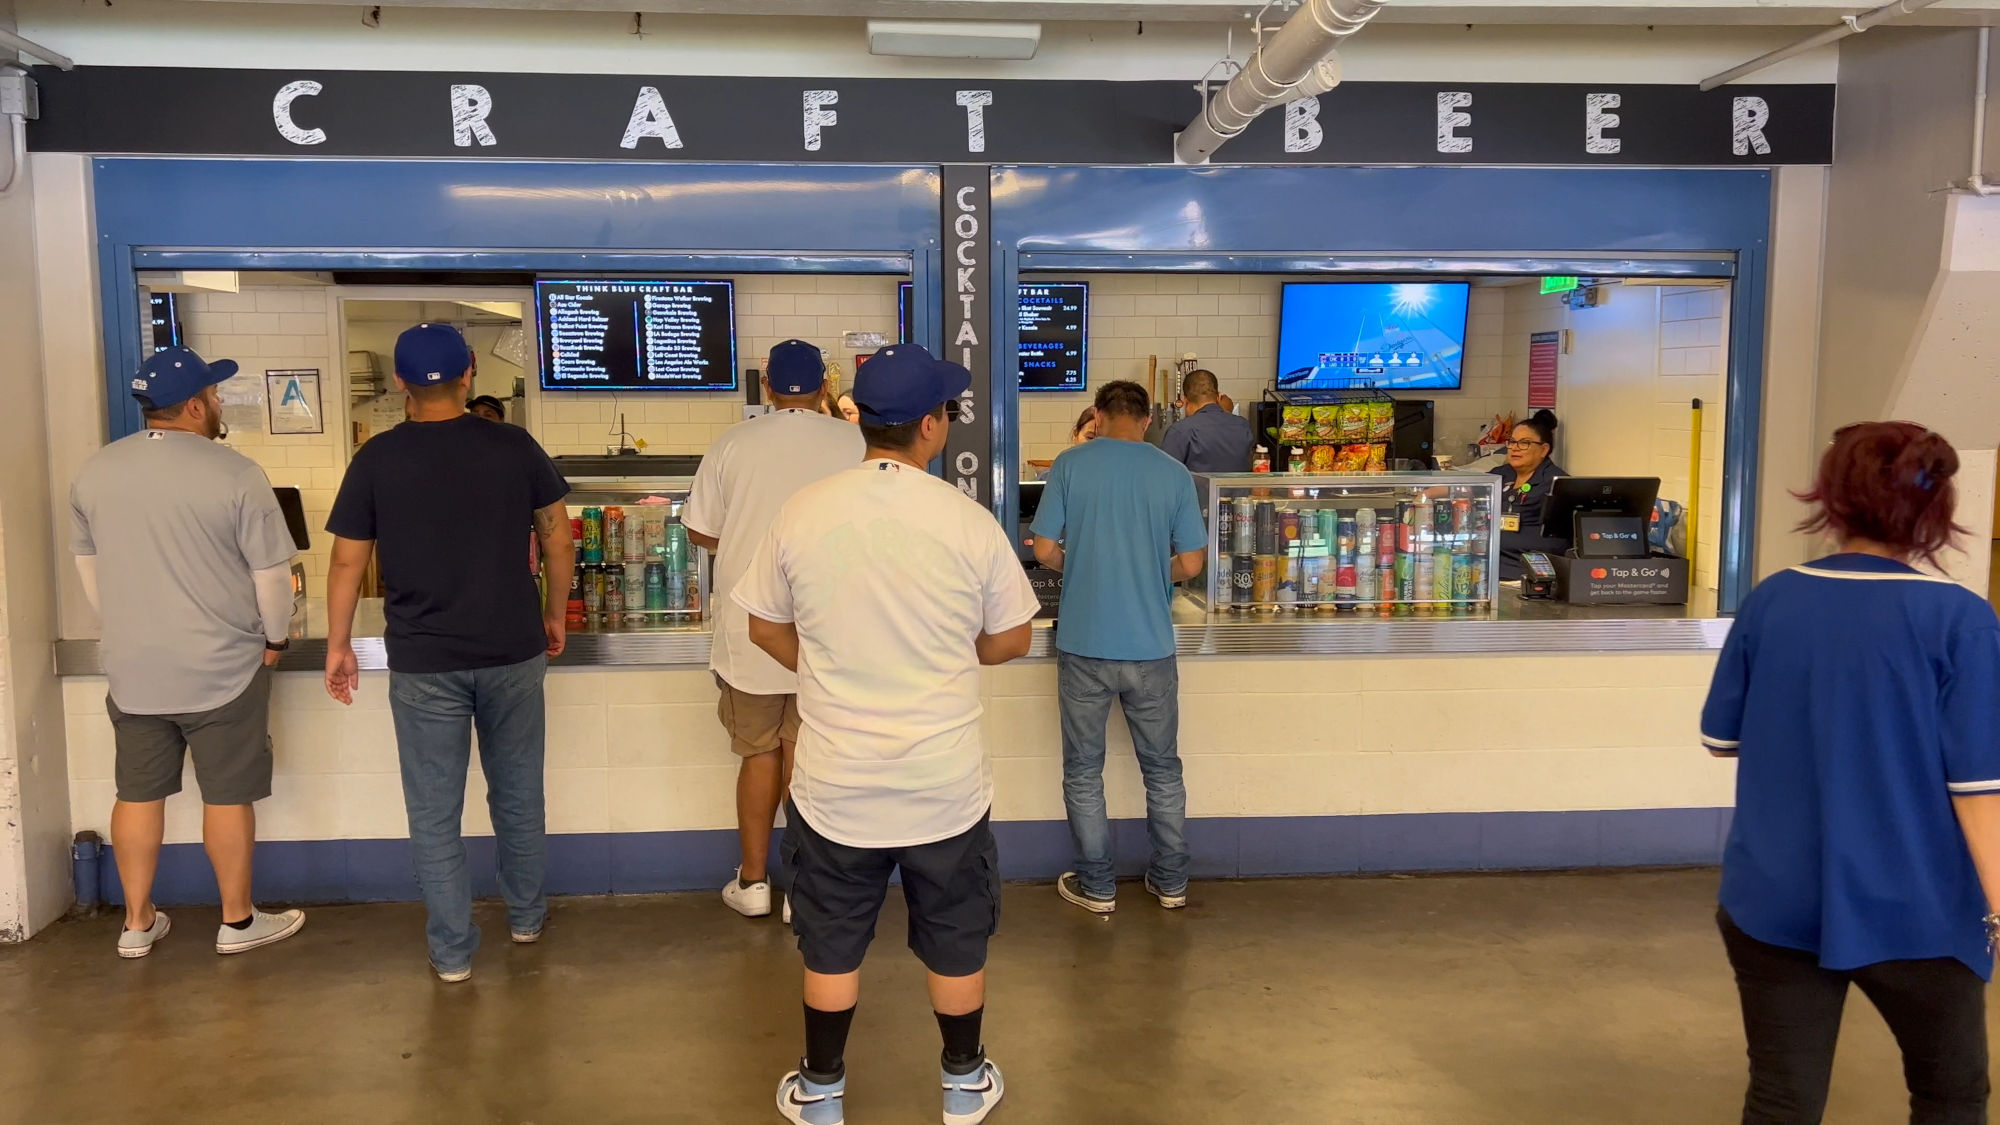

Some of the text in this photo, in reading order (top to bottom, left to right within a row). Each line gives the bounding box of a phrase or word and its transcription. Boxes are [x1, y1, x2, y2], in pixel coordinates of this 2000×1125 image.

[272, 80, 1771, 156] CRAFT BEER
[280, 380, 308, 406] A
[956, 451, 979, 500] ON
[1048, 579, 1055, 587] &
[1611, 568, 1629, 578] Tap
[1631, 568, 1638, 576] &
